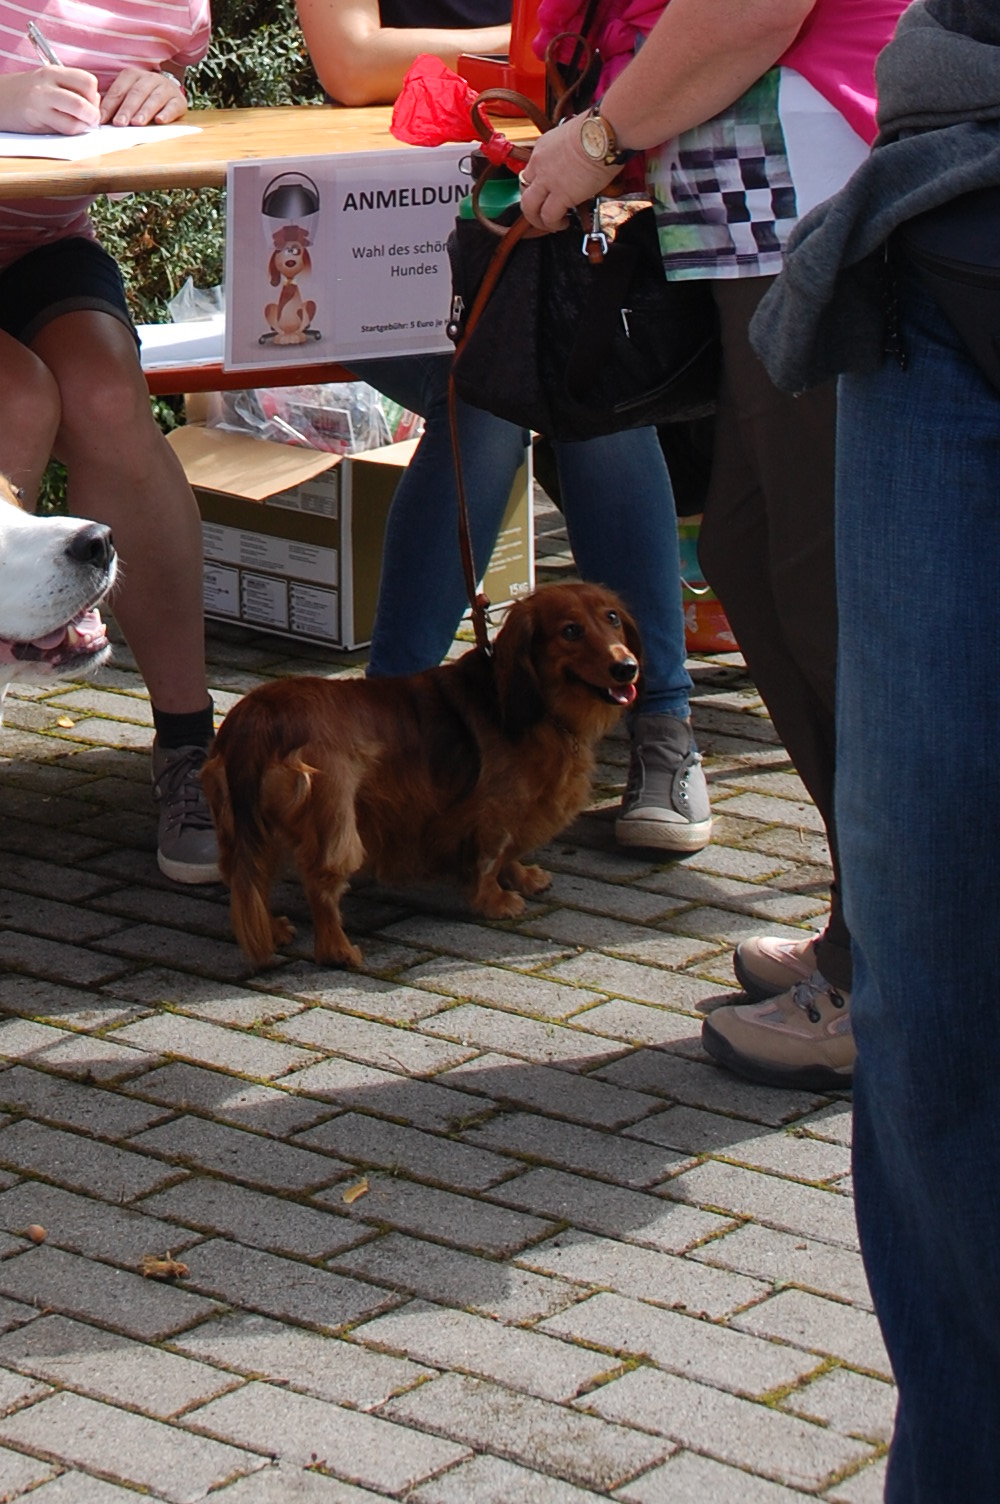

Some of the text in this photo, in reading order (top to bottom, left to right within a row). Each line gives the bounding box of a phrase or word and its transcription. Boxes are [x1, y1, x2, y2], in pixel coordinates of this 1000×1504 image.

[343, 184, 470, 211] ANMELDUN
[352, 241, 448, 258] Wahl des schön
[390, 263, 438, 277] Hundes
[361, 322, 409, 333] Startgebühr:
[410, 321, 415, 329] 5
[416, 320, 434, 328] Euro
[435, 319, 443, 328] je
